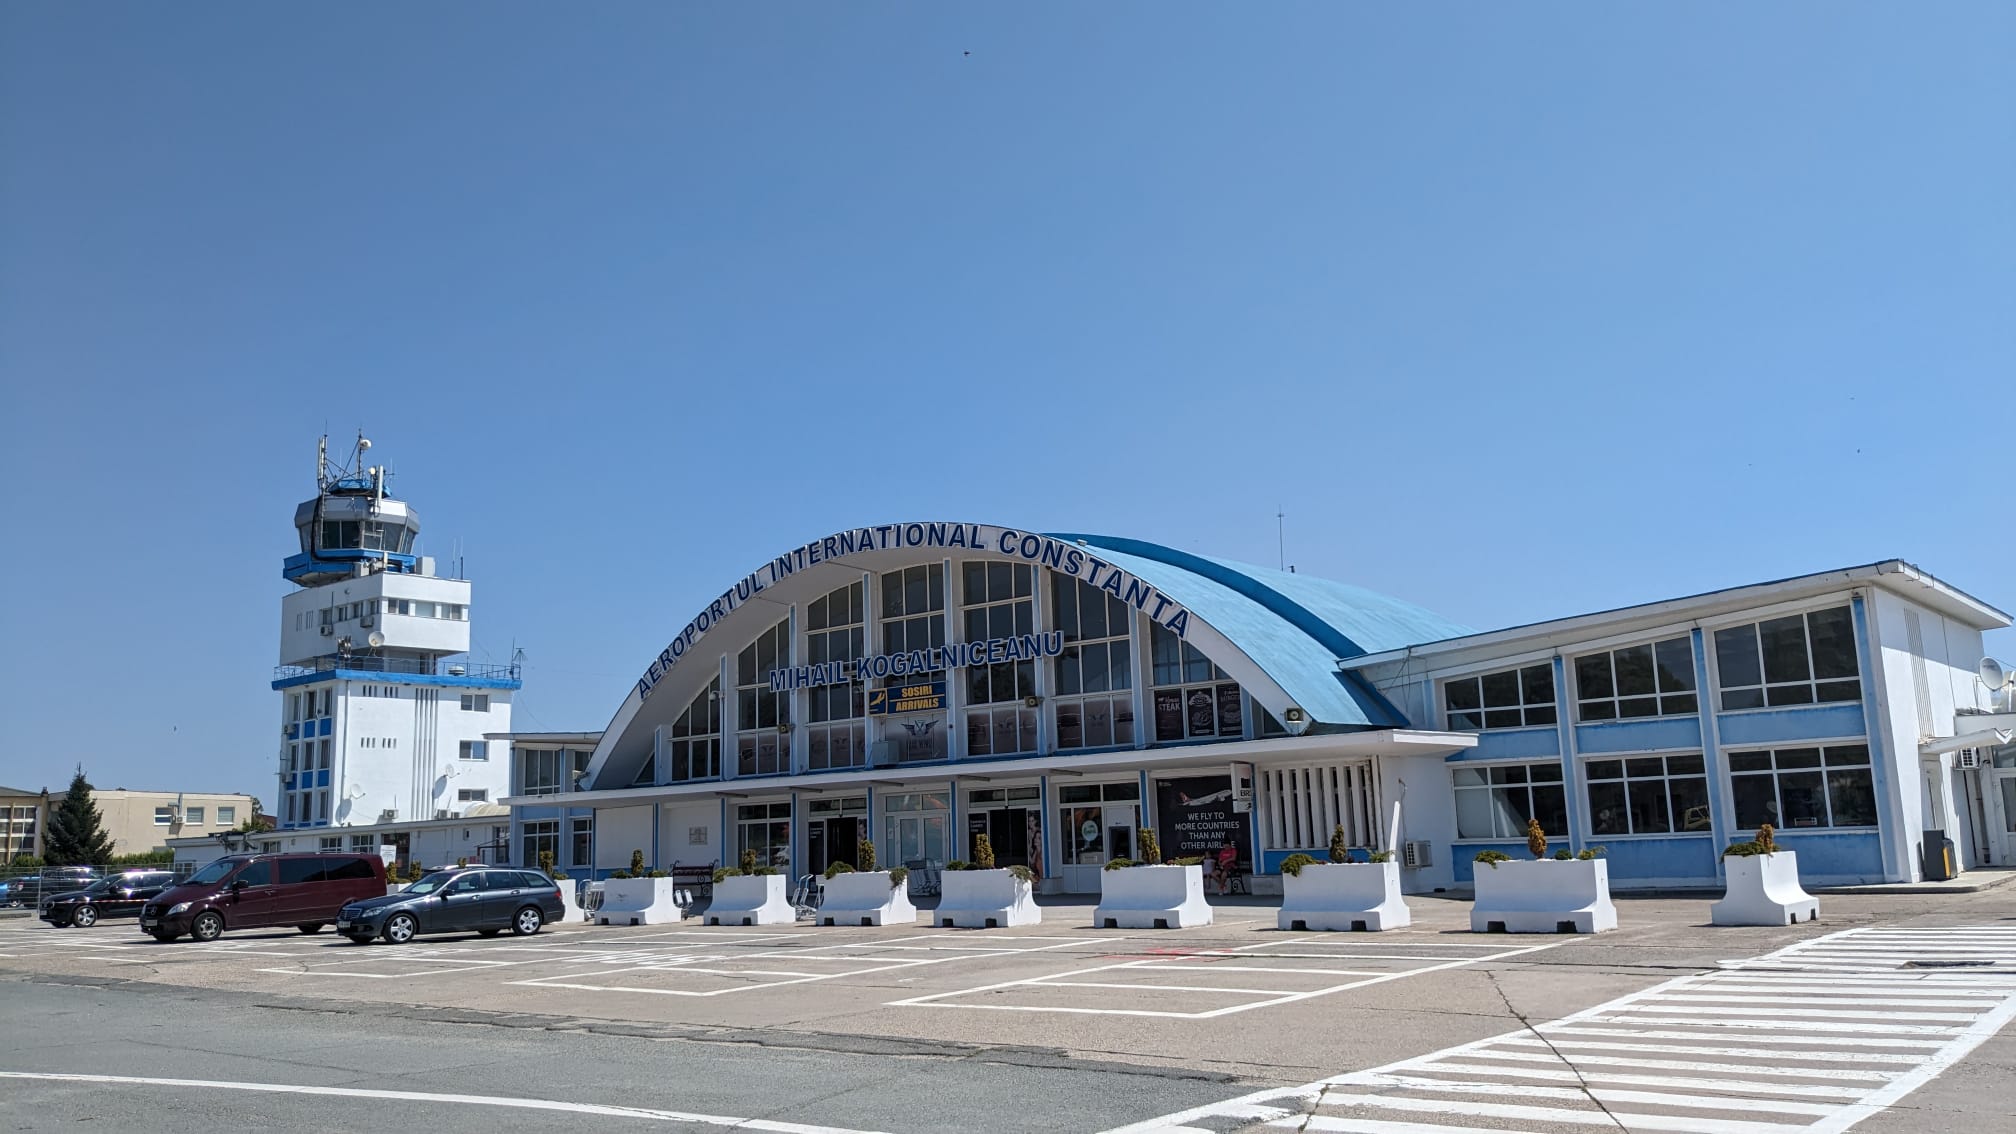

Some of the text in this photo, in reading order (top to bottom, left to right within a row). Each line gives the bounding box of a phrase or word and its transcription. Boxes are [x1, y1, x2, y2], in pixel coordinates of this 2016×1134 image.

[637, 522, 1192, 700] AEROPORTUL INTERNATIONAL CONSTANTA
[768, 630, 1065, 693] MIHAIL KOGALNICEANU
[901, 684, 933, 698] SOSIRI
[895, 697, 939, 712] ARRIVALS
[1239, 789, 1252, 797] BR
[1187, 811, 1225, 821] WE FLY TO
[1174, 820, 1240, 831] MORE COUNTRIES
[1189, 831, 1226, 840] THAN ANY
[1180, 840, 1236, 850] OTHER AIRLE
